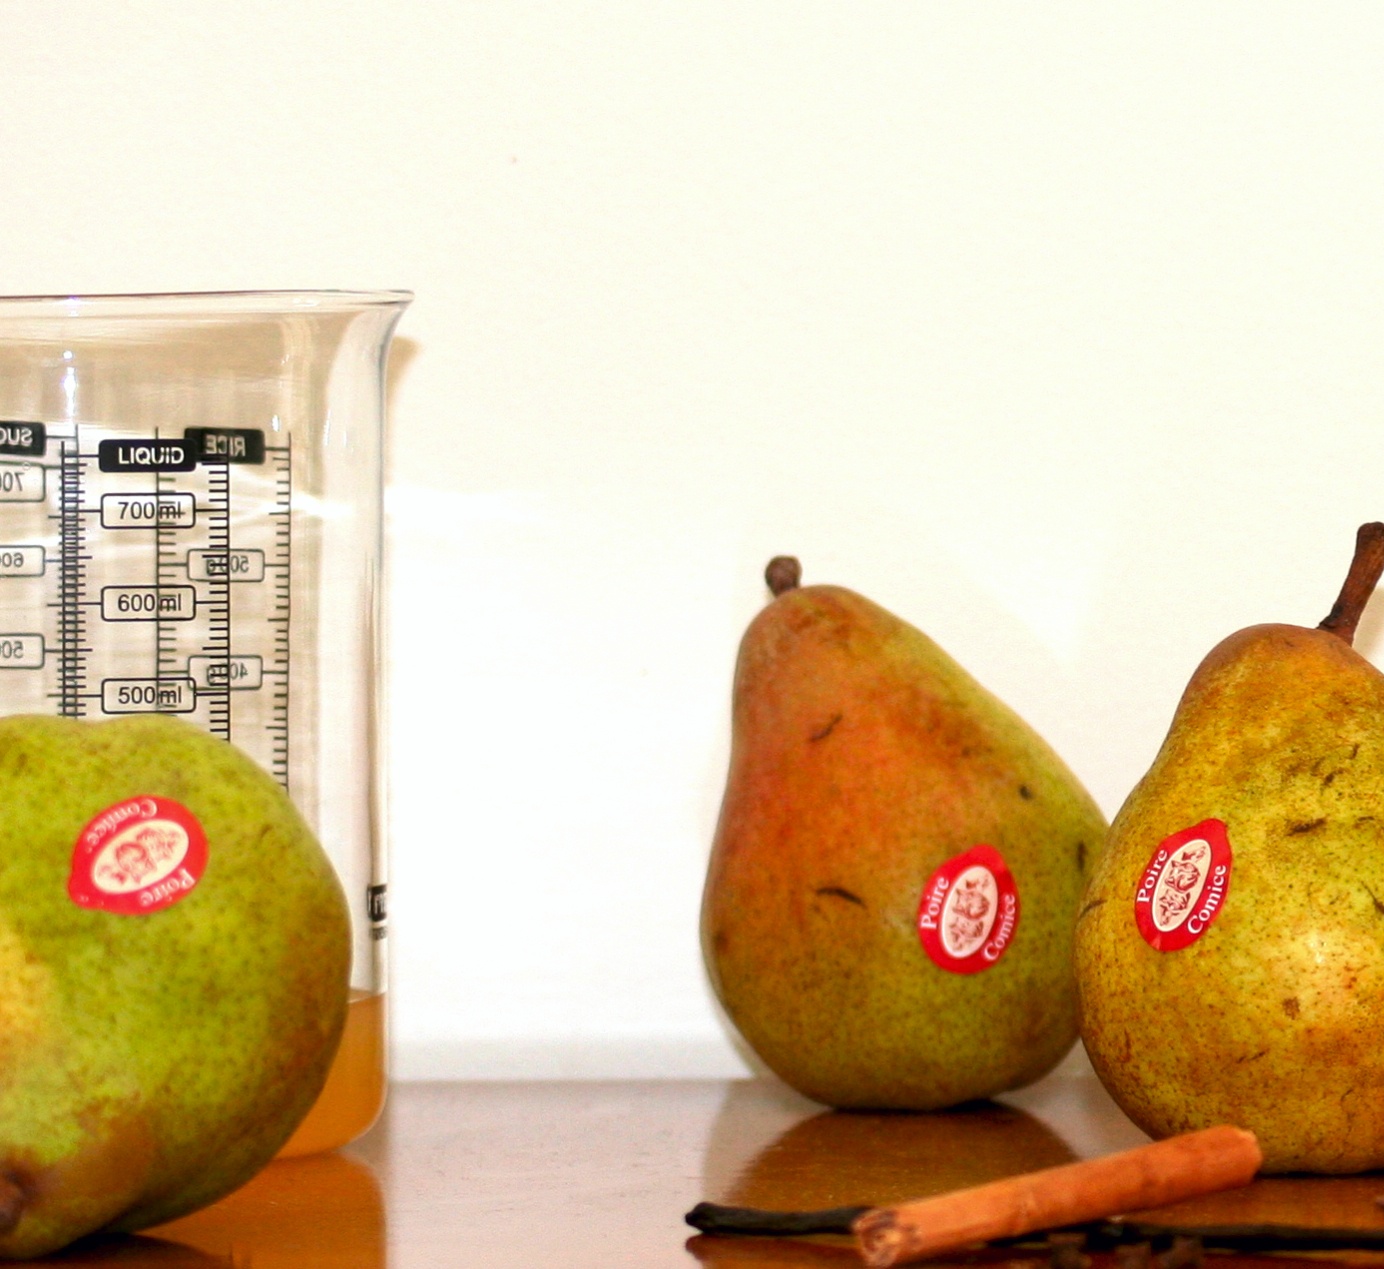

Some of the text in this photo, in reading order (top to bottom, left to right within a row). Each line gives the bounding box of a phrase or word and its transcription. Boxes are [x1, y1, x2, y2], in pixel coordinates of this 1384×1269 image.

[118, 446, 185, 465] LIQUID
[86, 798, 158, 846] Comice
[139, 868, 195, 907] Poire
[1137, 849, 1167, 903] Poire
[1187, 864, 1226, 934] Comice
[920, 877, 949, 929] Poire
[982, 894, 1015, 961] Comice
